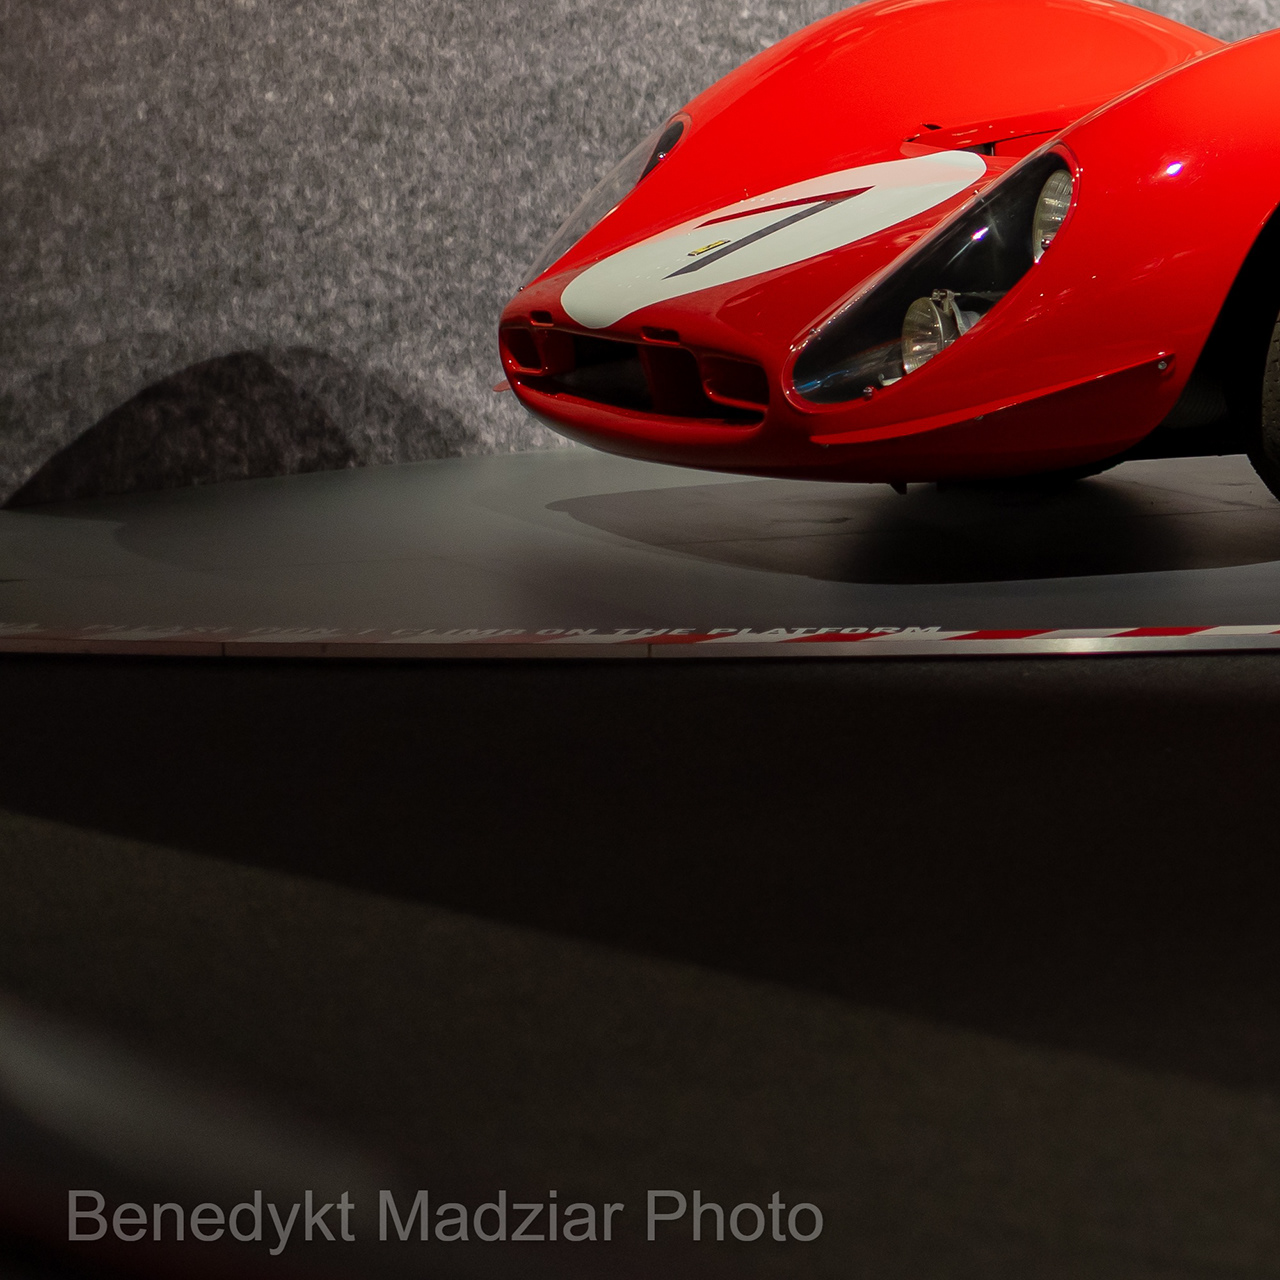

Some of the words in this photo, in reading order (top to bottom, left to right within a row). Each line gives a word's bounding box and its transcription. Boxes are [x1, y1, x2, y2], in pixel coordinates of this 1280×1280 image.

[662, 184, 876, 280] 7
[81, 624, 229, 633] PLEASE
[534, 627, 597, 635] ON
[610, 627, 694, 636] THE
[706, 626, 939, 635] PLATFORM
